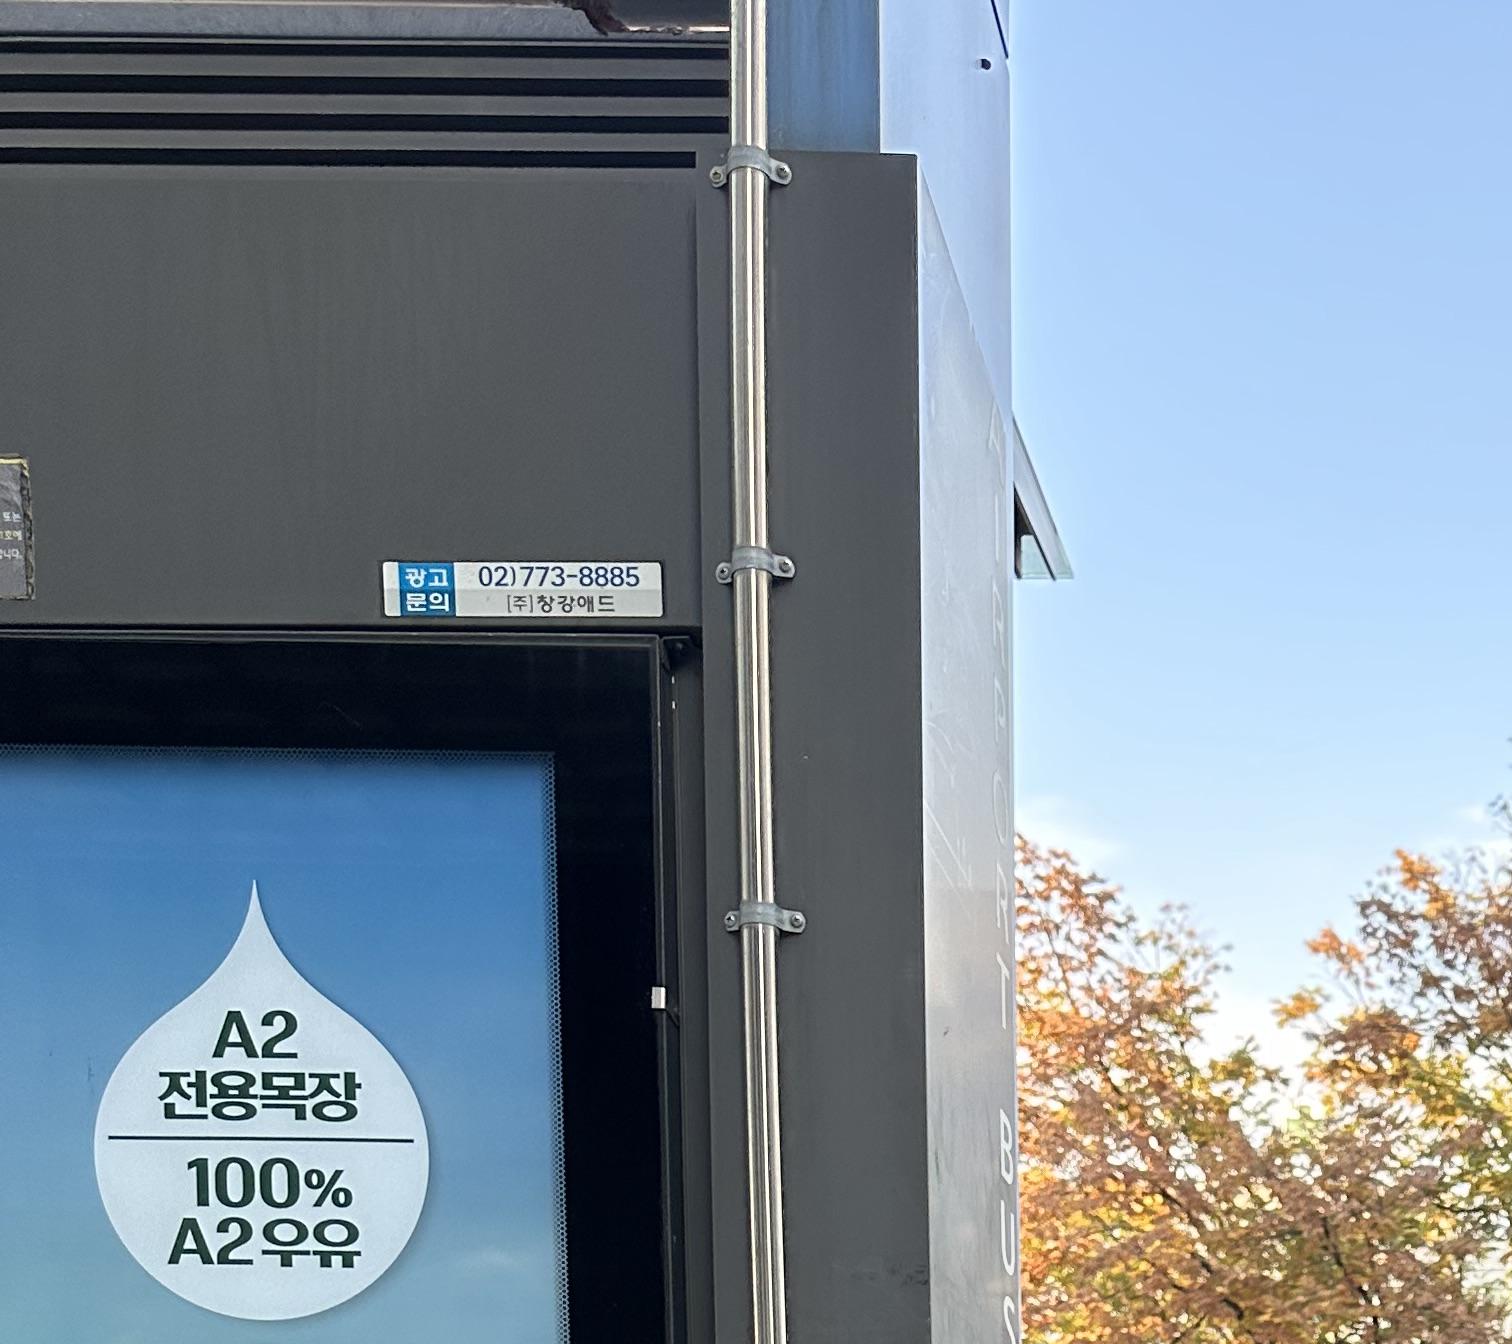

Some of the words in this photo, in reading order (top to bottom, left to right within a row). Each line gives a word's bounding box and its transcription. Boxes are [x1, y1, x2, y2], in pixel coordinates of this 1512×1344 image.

[405, 567, 449, 588] 광고
[478, 566, 640, 588] 02)773-8885
[406, 592, 450, 613] 문의
[212, 1009, 298, 1059] A2
[157, 1070, 362, 1122] 전용목장
[187, 1157, 353, 1209] 100%
[167, 1217, 362, 1268] A2우유
